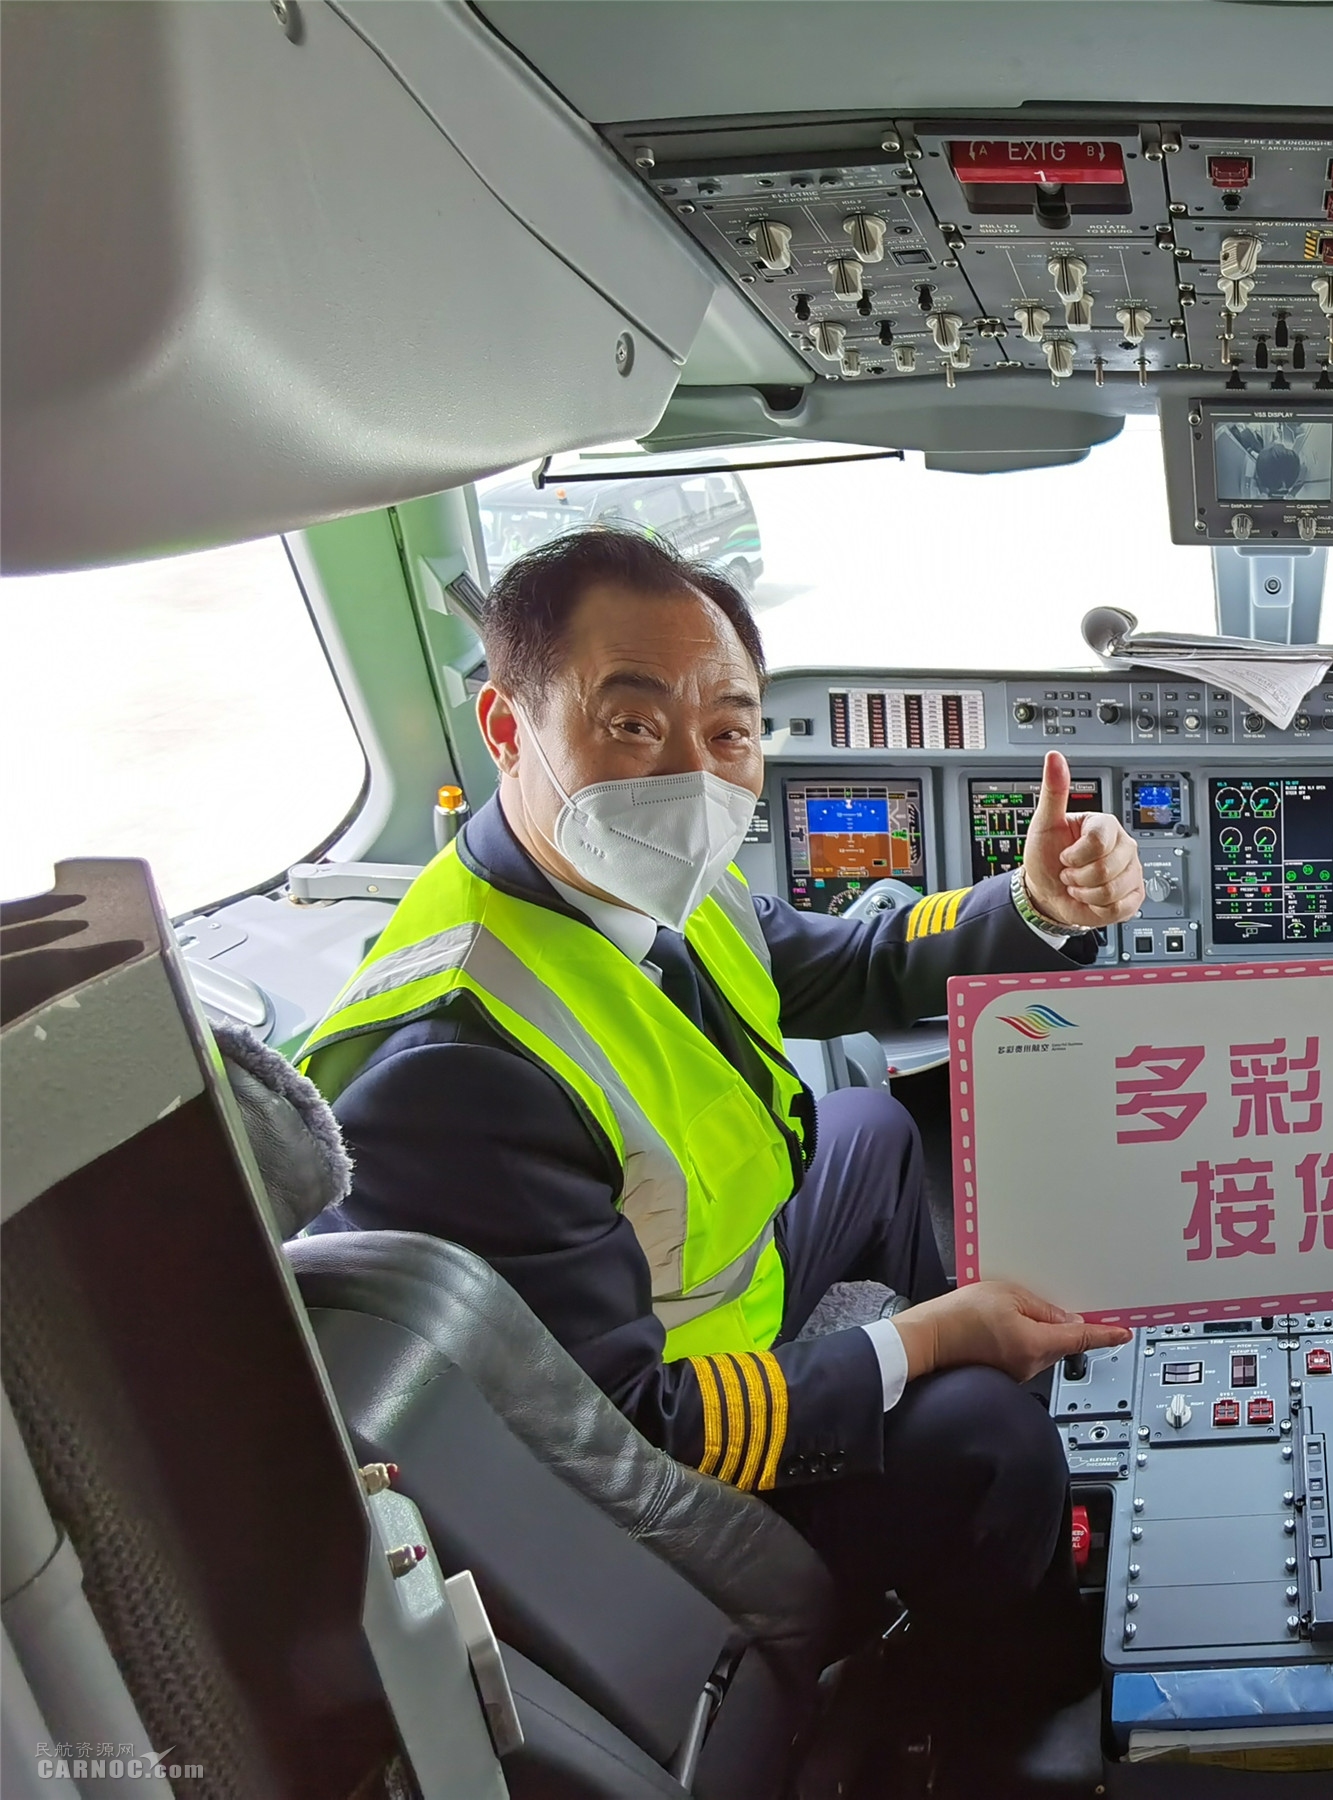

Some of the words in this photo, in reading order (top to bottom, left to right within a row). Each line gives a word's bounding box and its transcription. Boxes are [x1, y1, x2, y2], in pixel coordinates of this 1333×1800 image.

[978, 145, 988, 156] A
[1008, 141, 1066, 161] EXTG
[1086, 145, 1095, 157] B
[1034, 169, 1047, 182] 1
[771, 190, 819, 199] ELECTRIC
